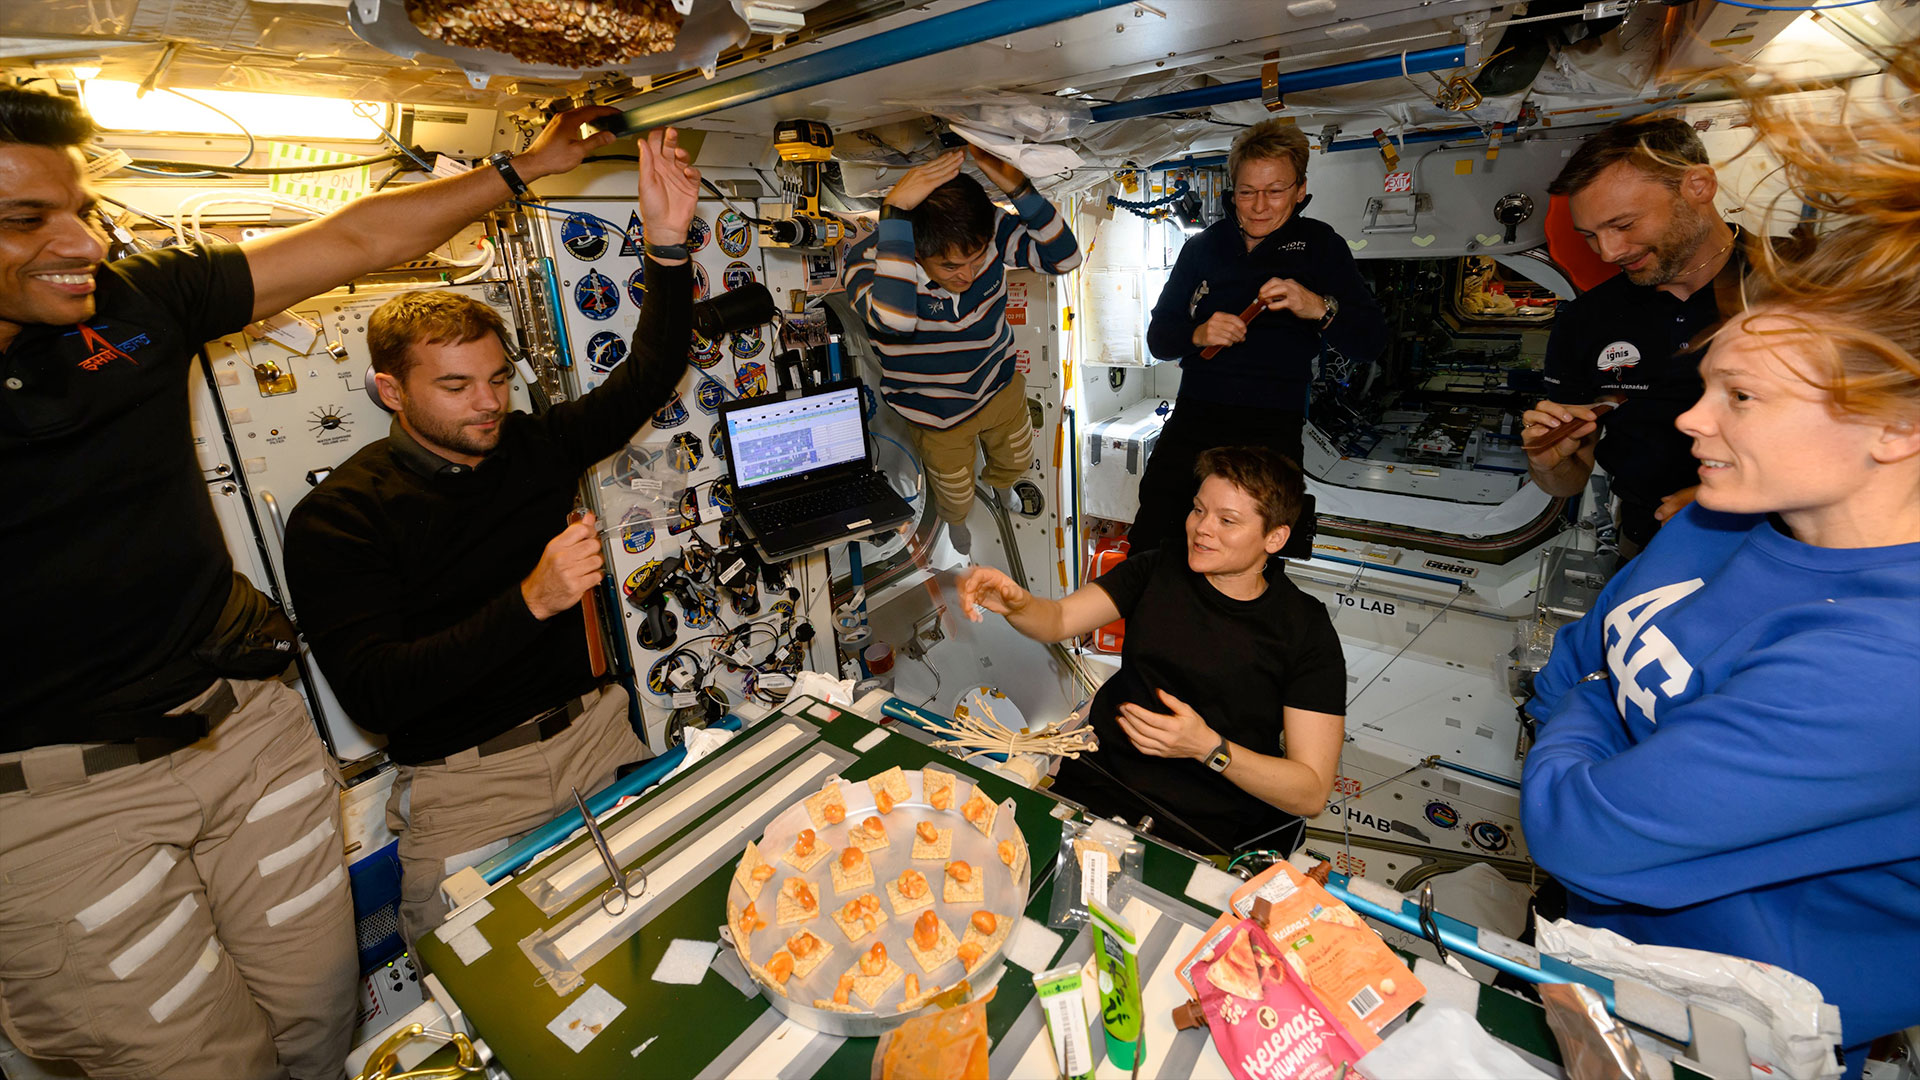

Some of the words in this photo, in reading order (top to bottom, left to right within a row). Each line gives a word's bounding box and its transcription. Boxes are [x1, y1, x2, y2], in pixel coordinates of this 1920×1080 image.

[1388, 178, 1406, 187] EXIT
[1606, 346, 1629, 361] ignis
[1336, 592, 1355, 607] To
[1360, 598, 1395, 615] LAB
[1347, 807, 1391, 833] HAB
[1241, 1004, 1326, 1078] Helena's
[1269, 1031, 1324, 1080] HUMMUS
